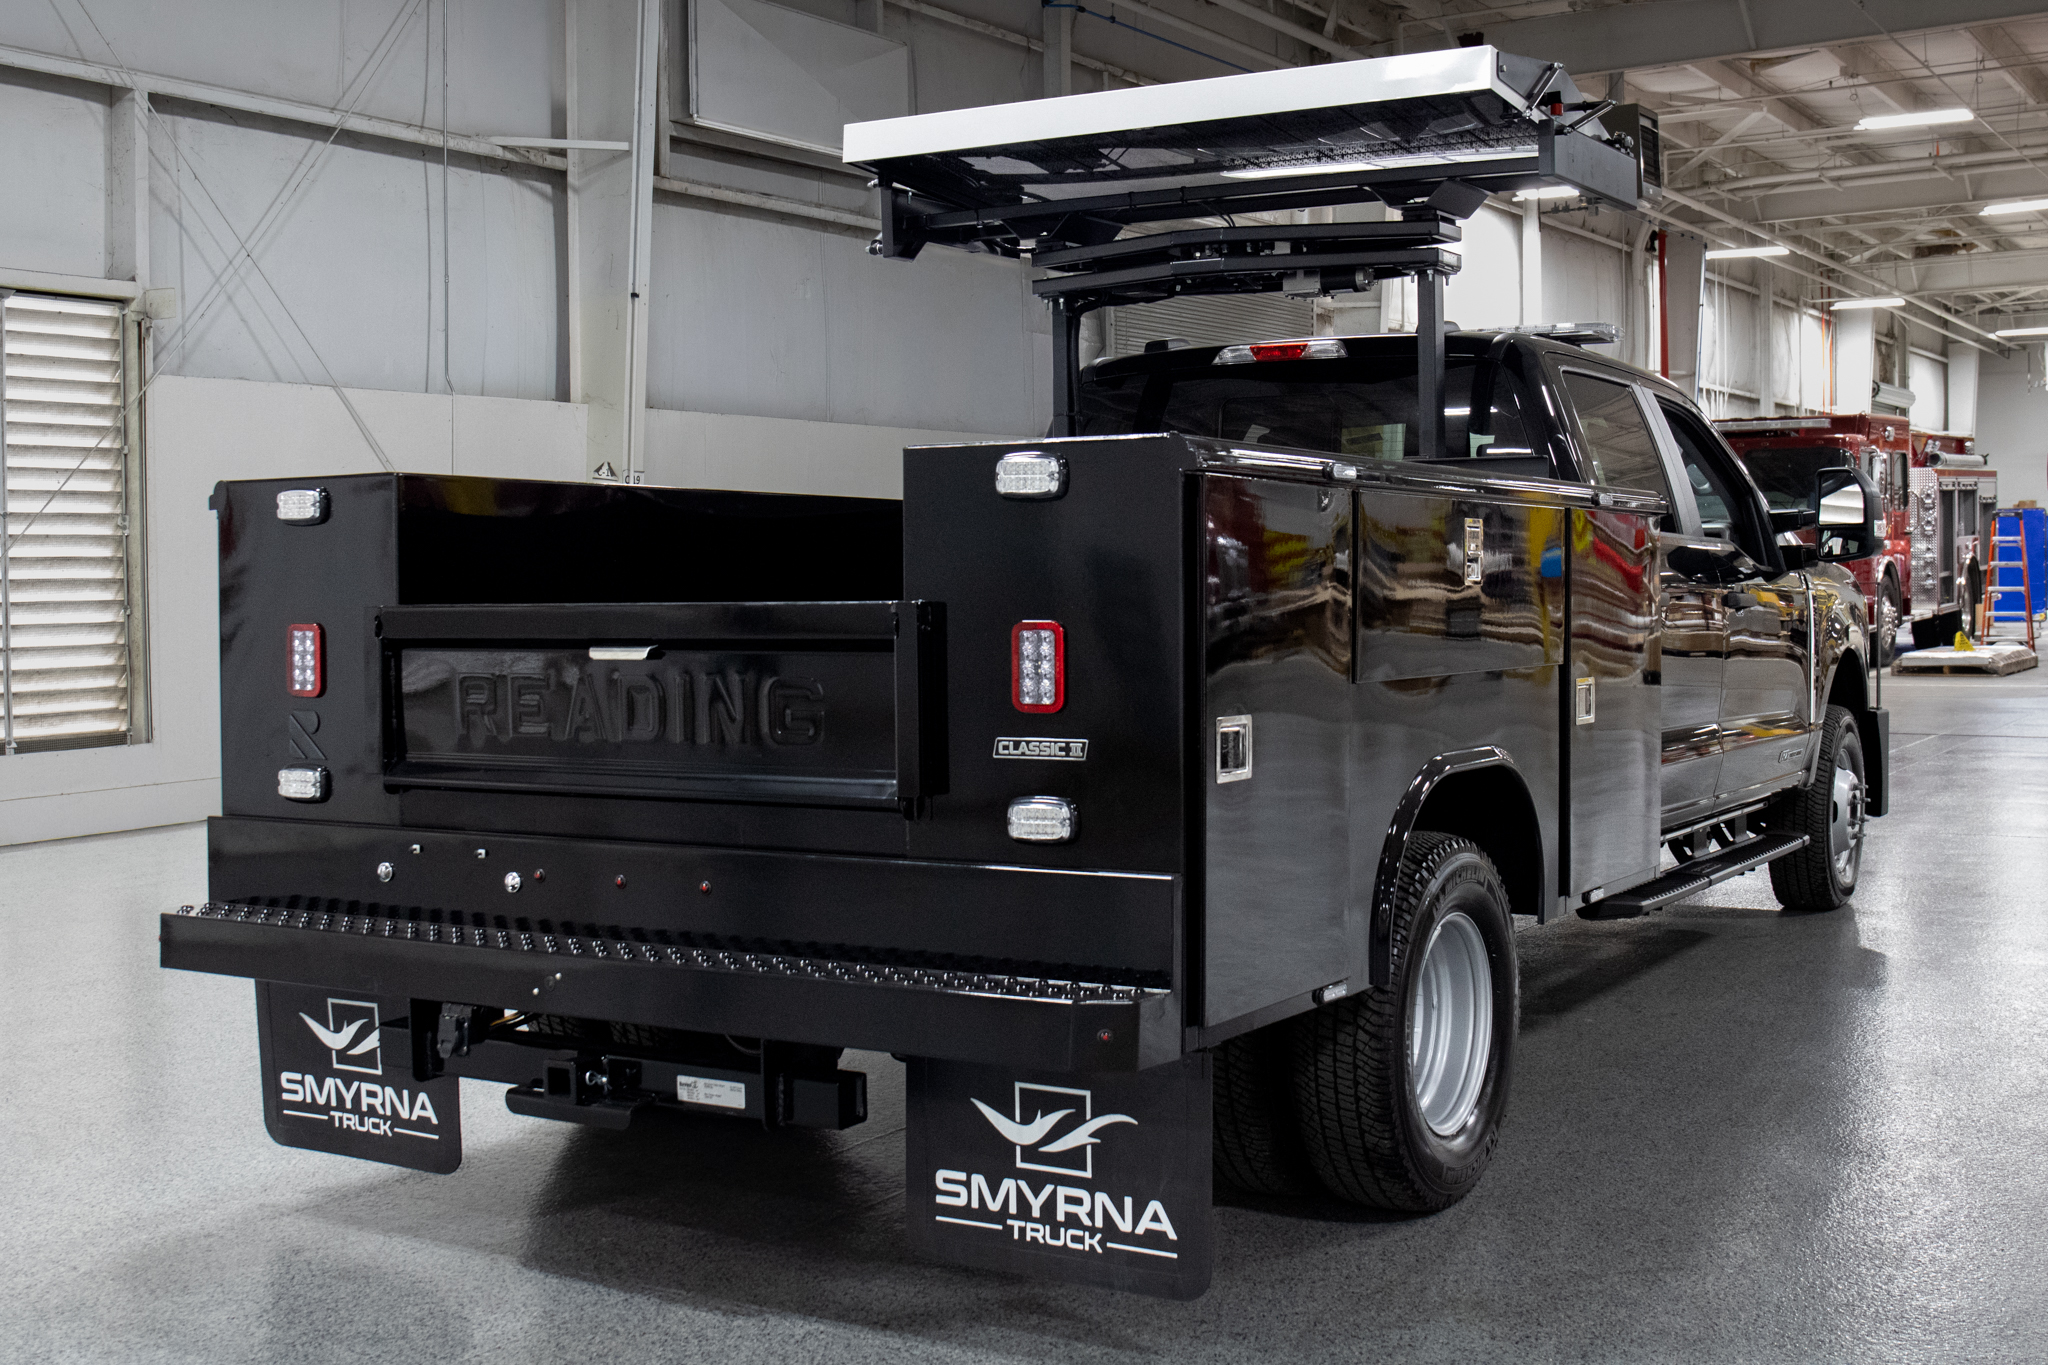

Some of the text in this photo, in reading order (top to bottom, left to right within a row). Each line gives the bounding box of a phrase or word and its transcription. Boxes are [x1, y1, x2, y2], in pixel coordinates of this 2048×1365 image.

[455, 672, 825, 746] READING
[998, 741, 1083, 757] CLASSIC II
[280, 1071, 438, 1125] SMYRNA
[329, 1111, 393, 1137] TRUCK
[935, 1169, 1178, 1240] SMYRNA
[1006, 1219, 1102, 1253] TRUCK
